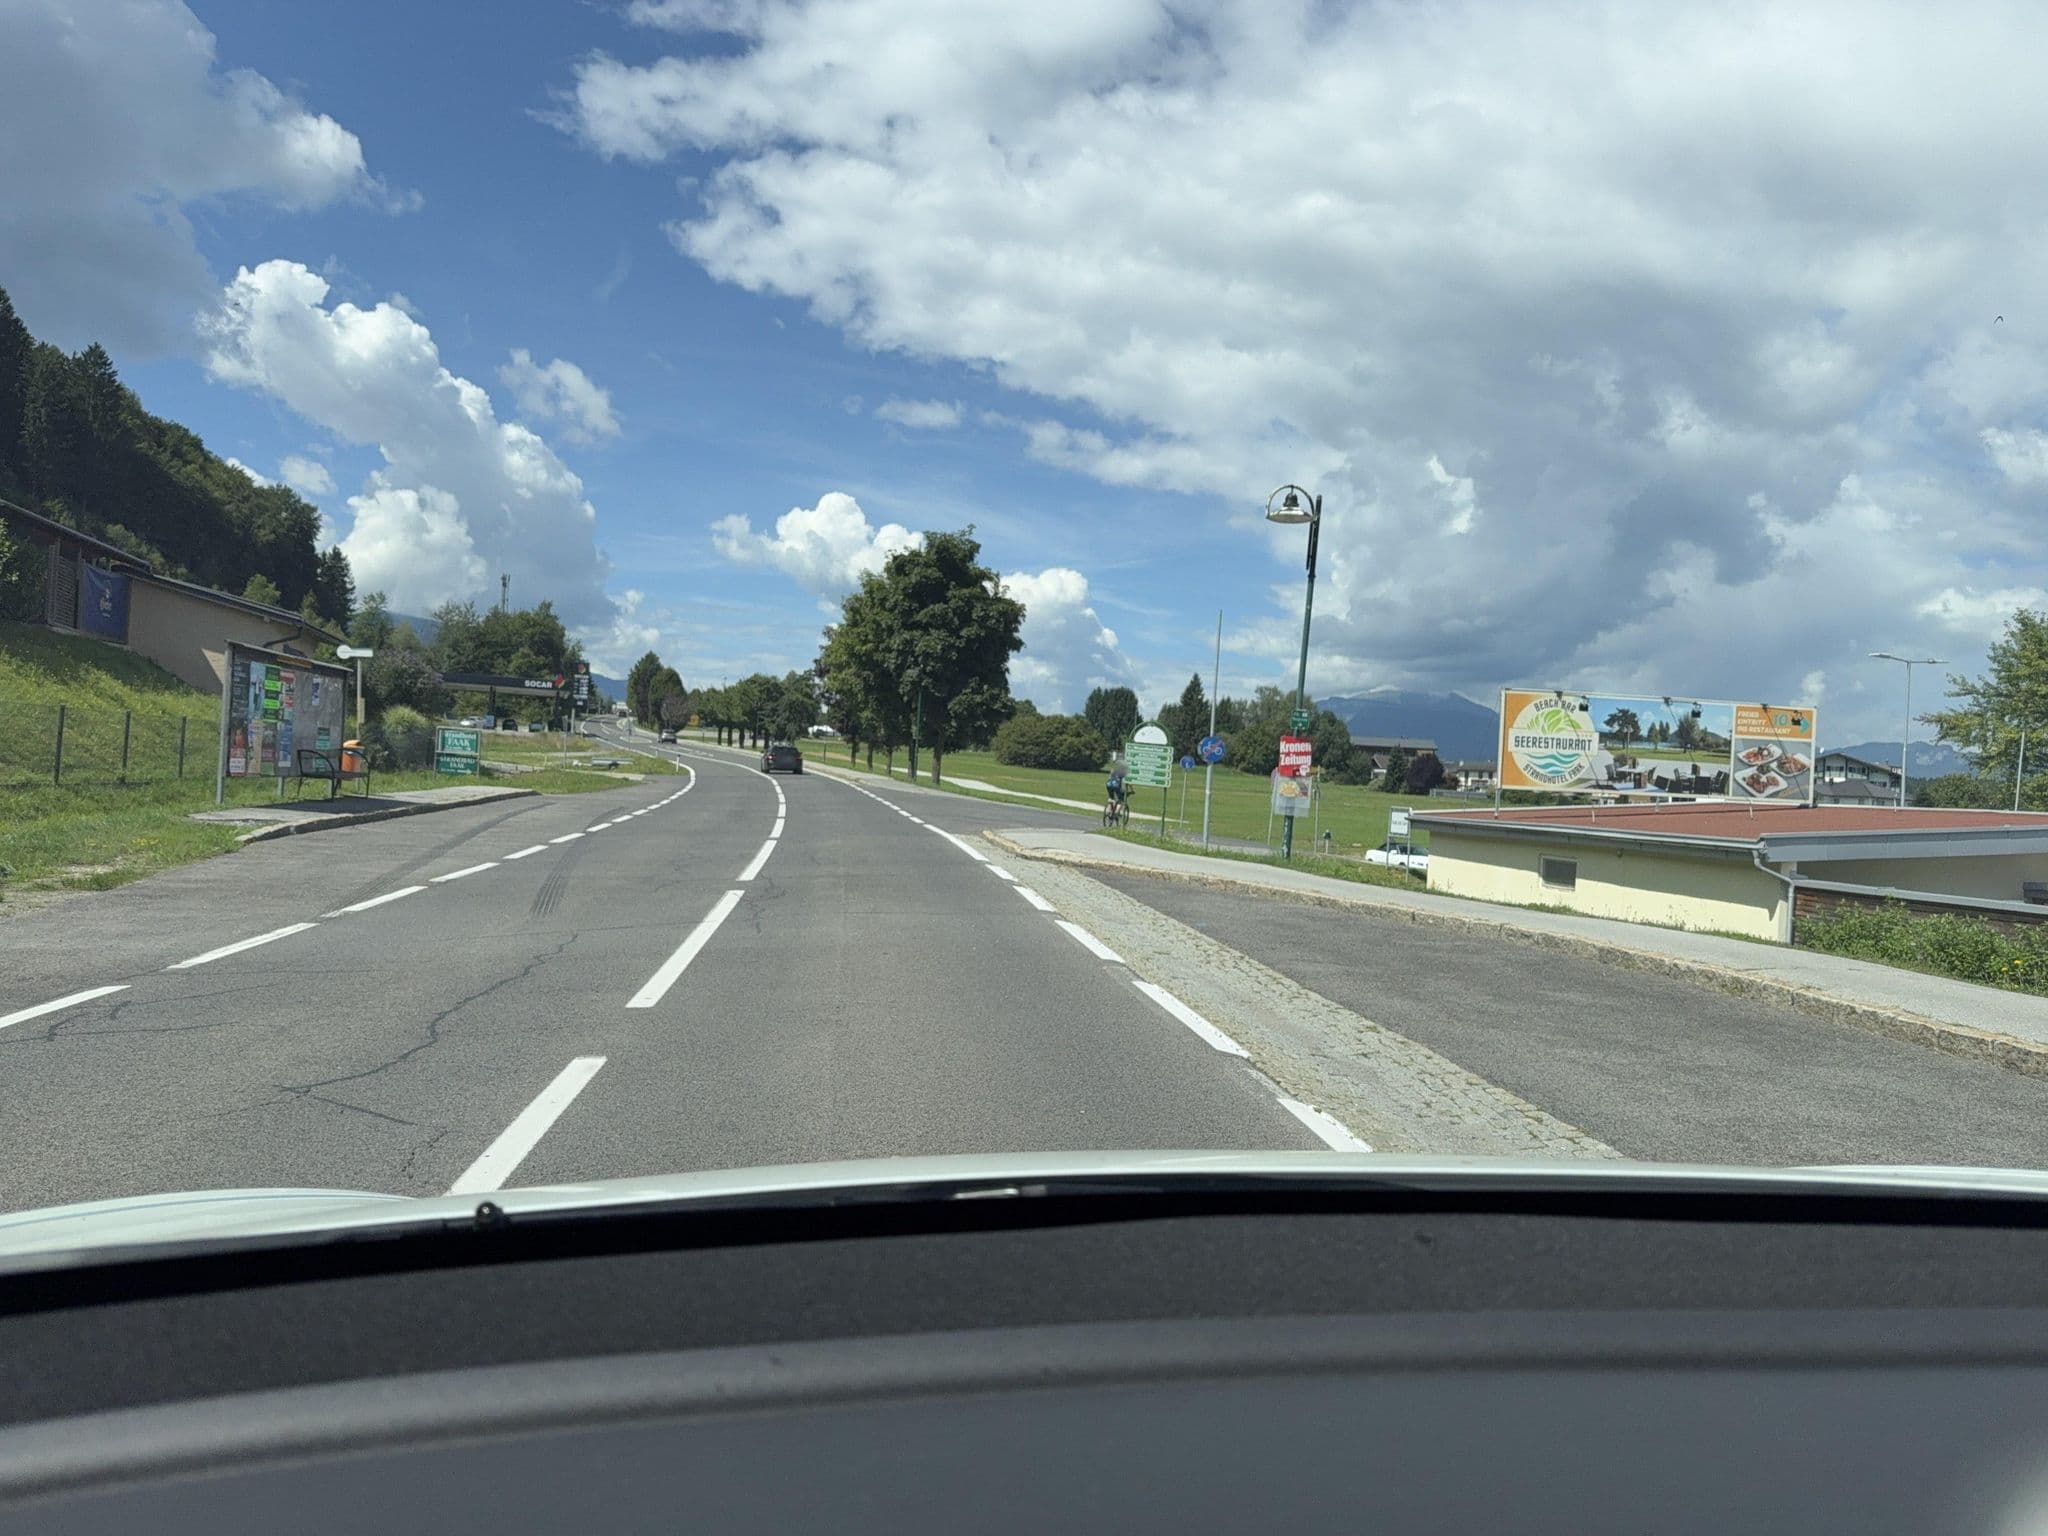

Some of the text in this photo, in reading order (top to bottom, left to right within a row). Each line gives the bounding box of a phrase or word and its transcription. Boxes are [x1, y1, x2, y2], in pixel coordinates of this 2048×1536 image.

[524, 679, 553, 689] SOCAR
[1533, 698, 1577, 714] BEACH BAR
[1279, 741, 1312, 753] Kronen
[1514, 735, 1593, 752] SEERESTAURANT
[1279, 753, 1312, 766] Zeitung
[1522, 763, 1569, 785] STRANDHOTEL
